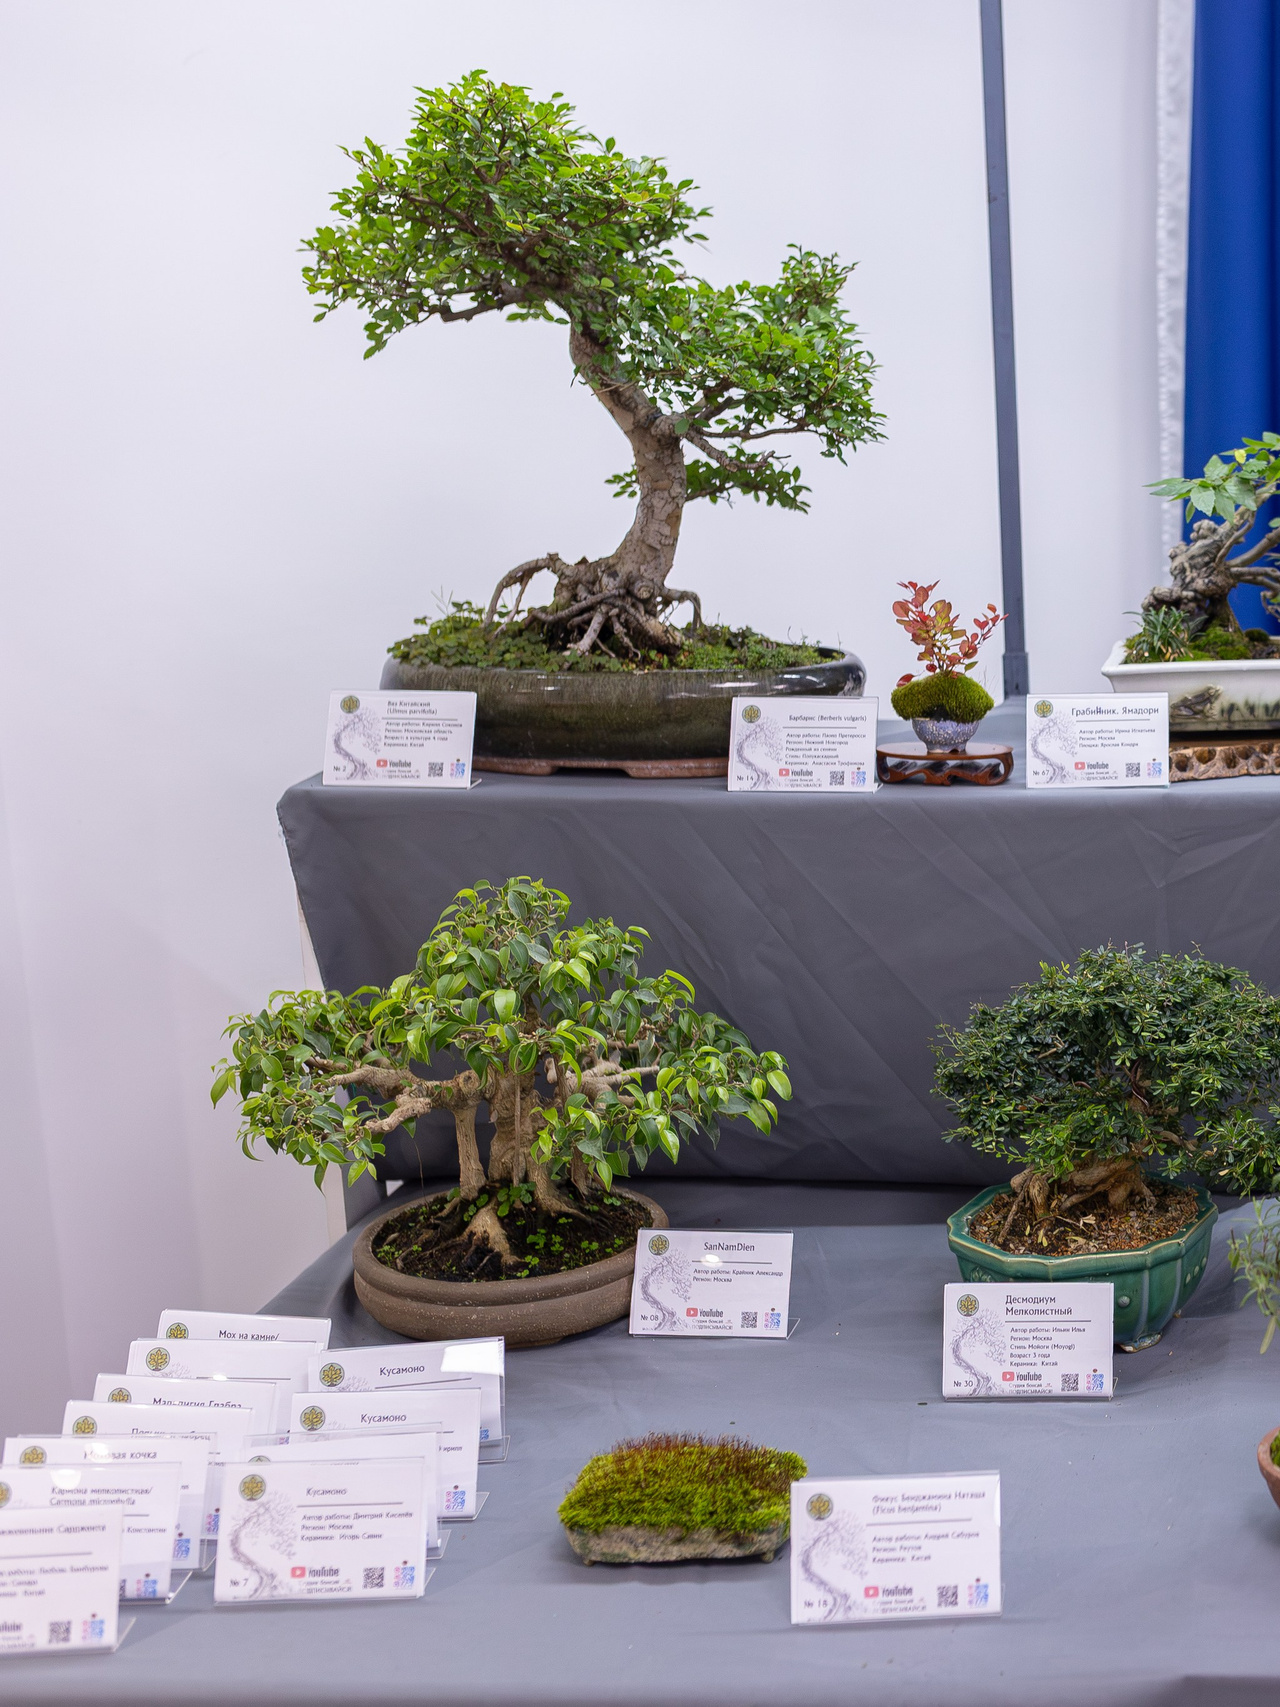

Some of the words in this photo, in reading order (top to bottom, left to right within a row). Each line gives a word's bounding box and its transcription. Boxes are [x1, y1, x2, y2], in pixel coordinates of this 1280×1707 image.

[1122, 707, 1159, 715] Ямадори
[704, 1242, 755, 1251] SanNamDien
[1006, 1295, 1056, 1304] Десмодиум
[700, 1309, 723, 1317] YouTube
[1006, 1307, 1072, 1315] Мелколистный
[219, 1330, 235, 1338] Мох
[379, 1365, 425, 1375] Кусамоно
[1016, 1372, 1042, 1381] YouTube
[361, 1413, 407, 1423] Кусамоно
[306, 1488, 347, 1497] Кусамоно
[308, 1567, 340, 1577] YouTube
[882, 1586, 913, 1596] YouTube
